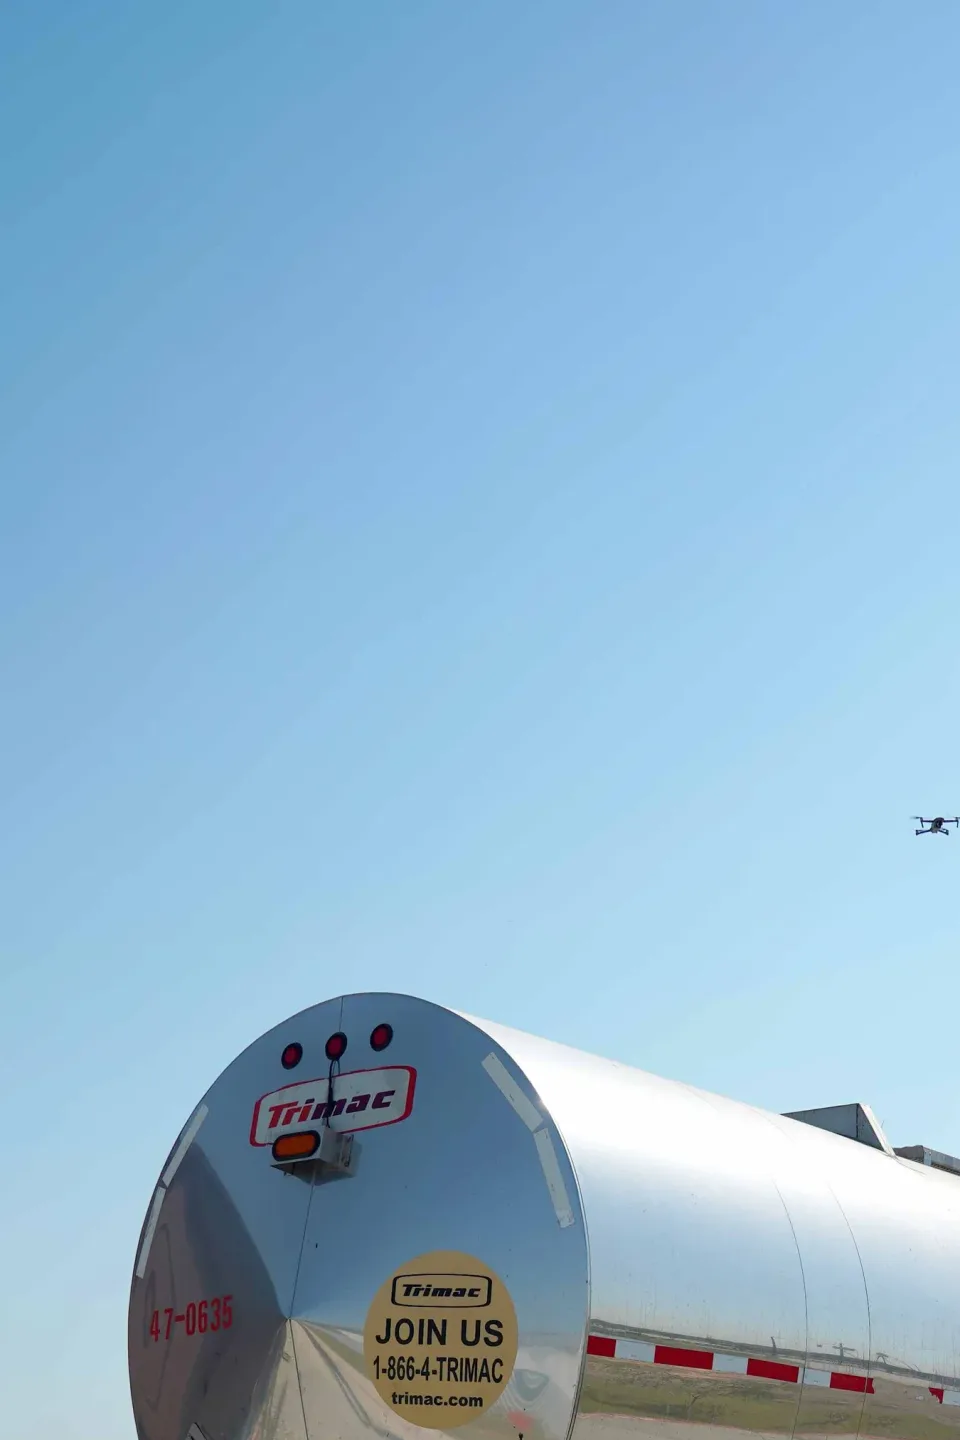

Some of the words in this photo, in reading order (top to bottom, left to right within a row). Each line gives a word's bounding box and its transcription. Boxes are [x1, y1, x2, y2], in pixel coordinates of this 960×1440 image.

[268, 1090, 396, 1128] Trimac
[402, 1284, 481, 1297] Trimac
[150, 1294, 232, 1342] 47-0635
[375, 1318, 447, 1345] JOIN
[461, 1319, 504, 1347] US
[373, 1355, 503, 1383] 1-866-4-TRIMAC
[391, 1391, 483, 1407] trimac.com
